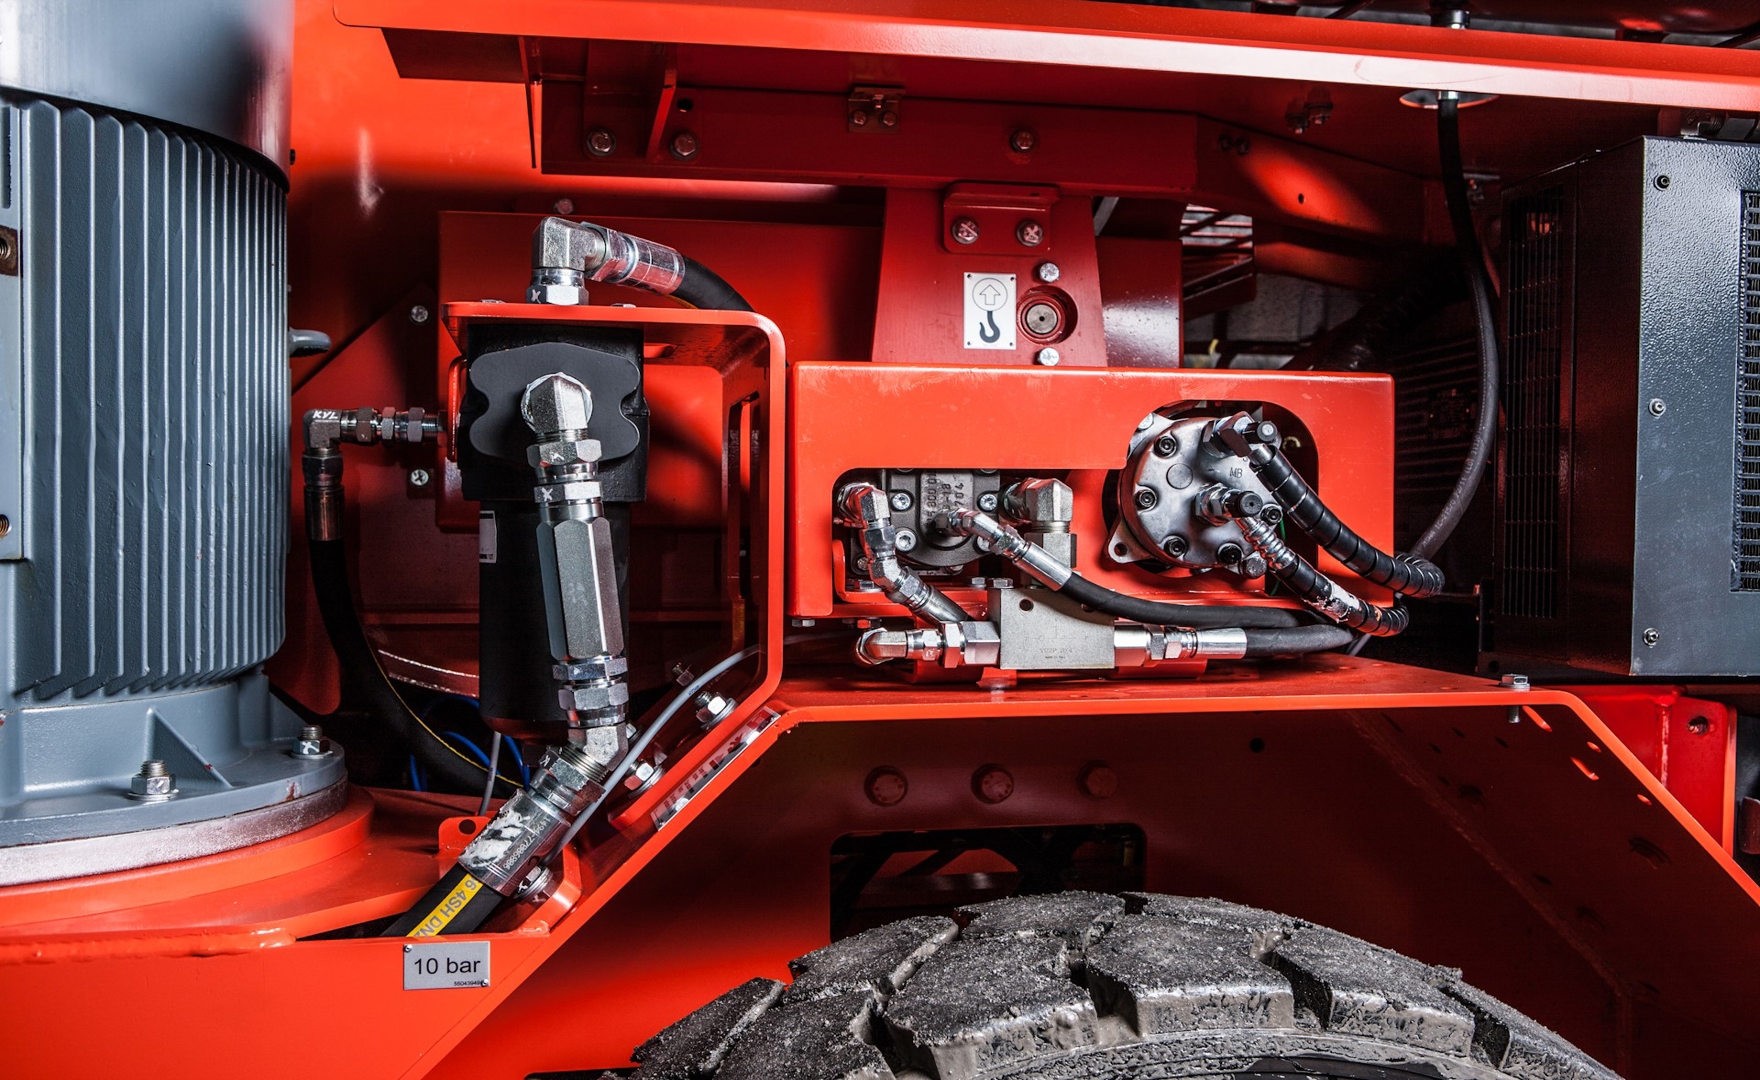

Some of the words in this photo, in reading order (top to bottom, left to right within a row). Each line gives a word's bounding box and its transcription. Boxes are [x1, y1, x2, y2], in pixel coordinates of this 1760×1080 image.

[312, 410, 338, 420] KYL
[1229, 467, 1243, 479] MB
[440, 890, 467, 918] 4SH
[414, 957, 439, 975] 10
[446, 957, 481, 974] bar
